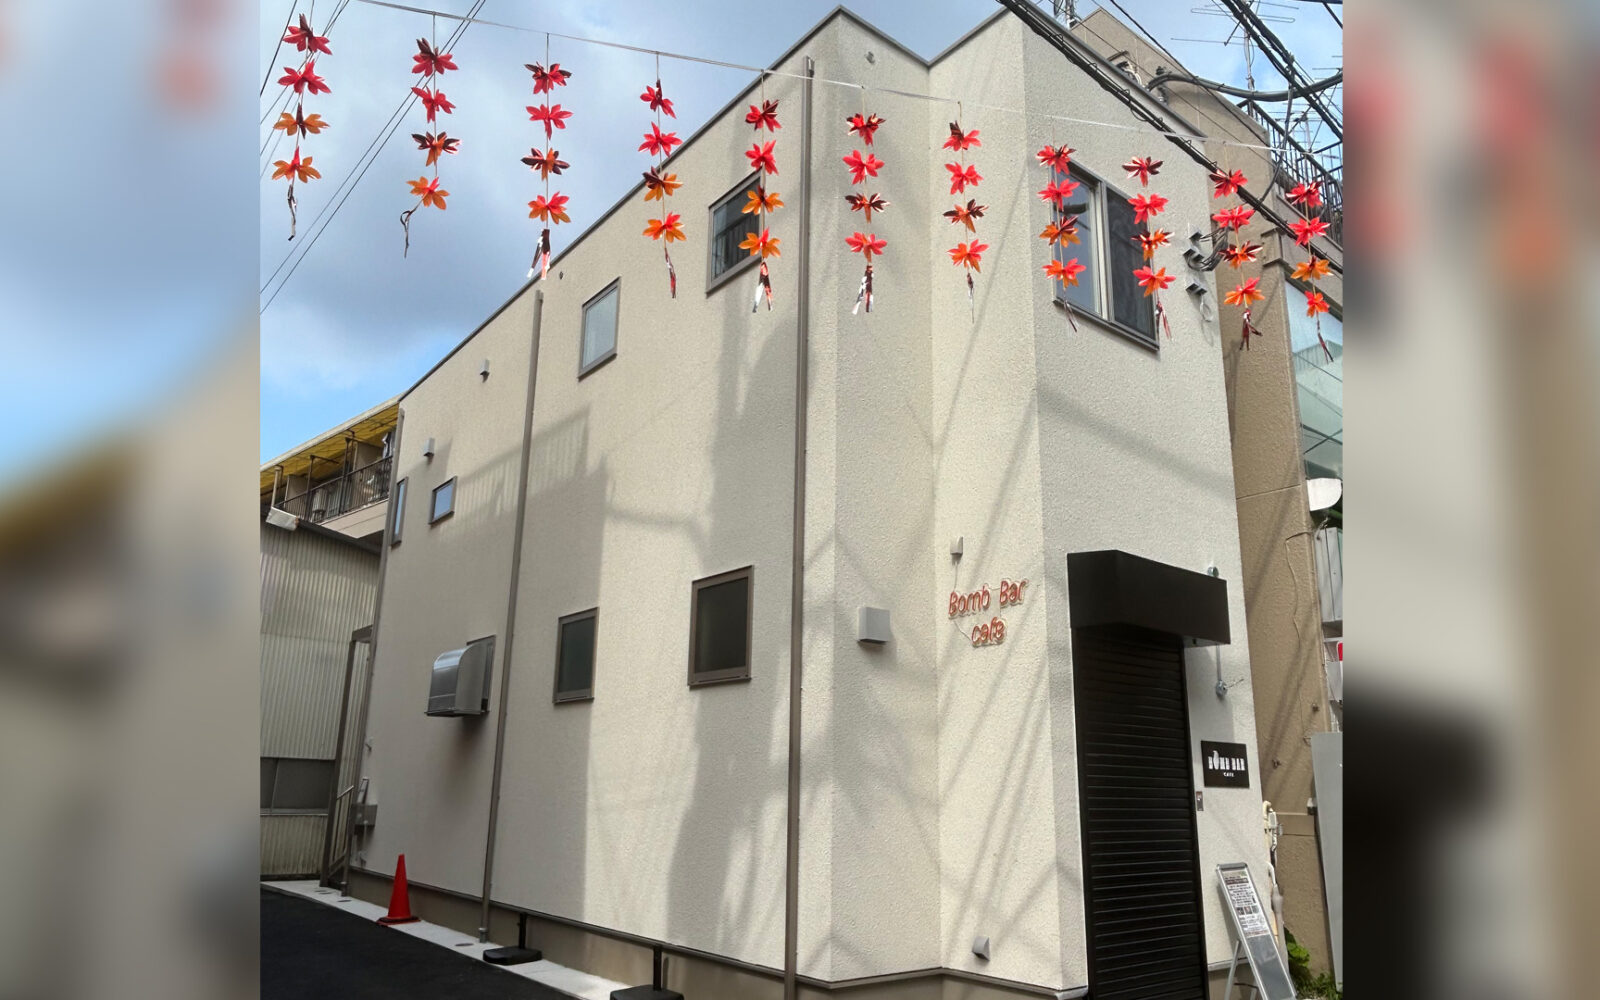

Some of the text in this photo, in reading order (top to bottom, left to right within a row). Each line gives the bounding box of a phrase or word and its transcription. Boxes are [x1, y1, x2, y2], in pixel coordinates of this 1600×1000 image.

[948, 578, 1029, 618] Bomb Bar
[971, 616, 1006, 647] cafe
